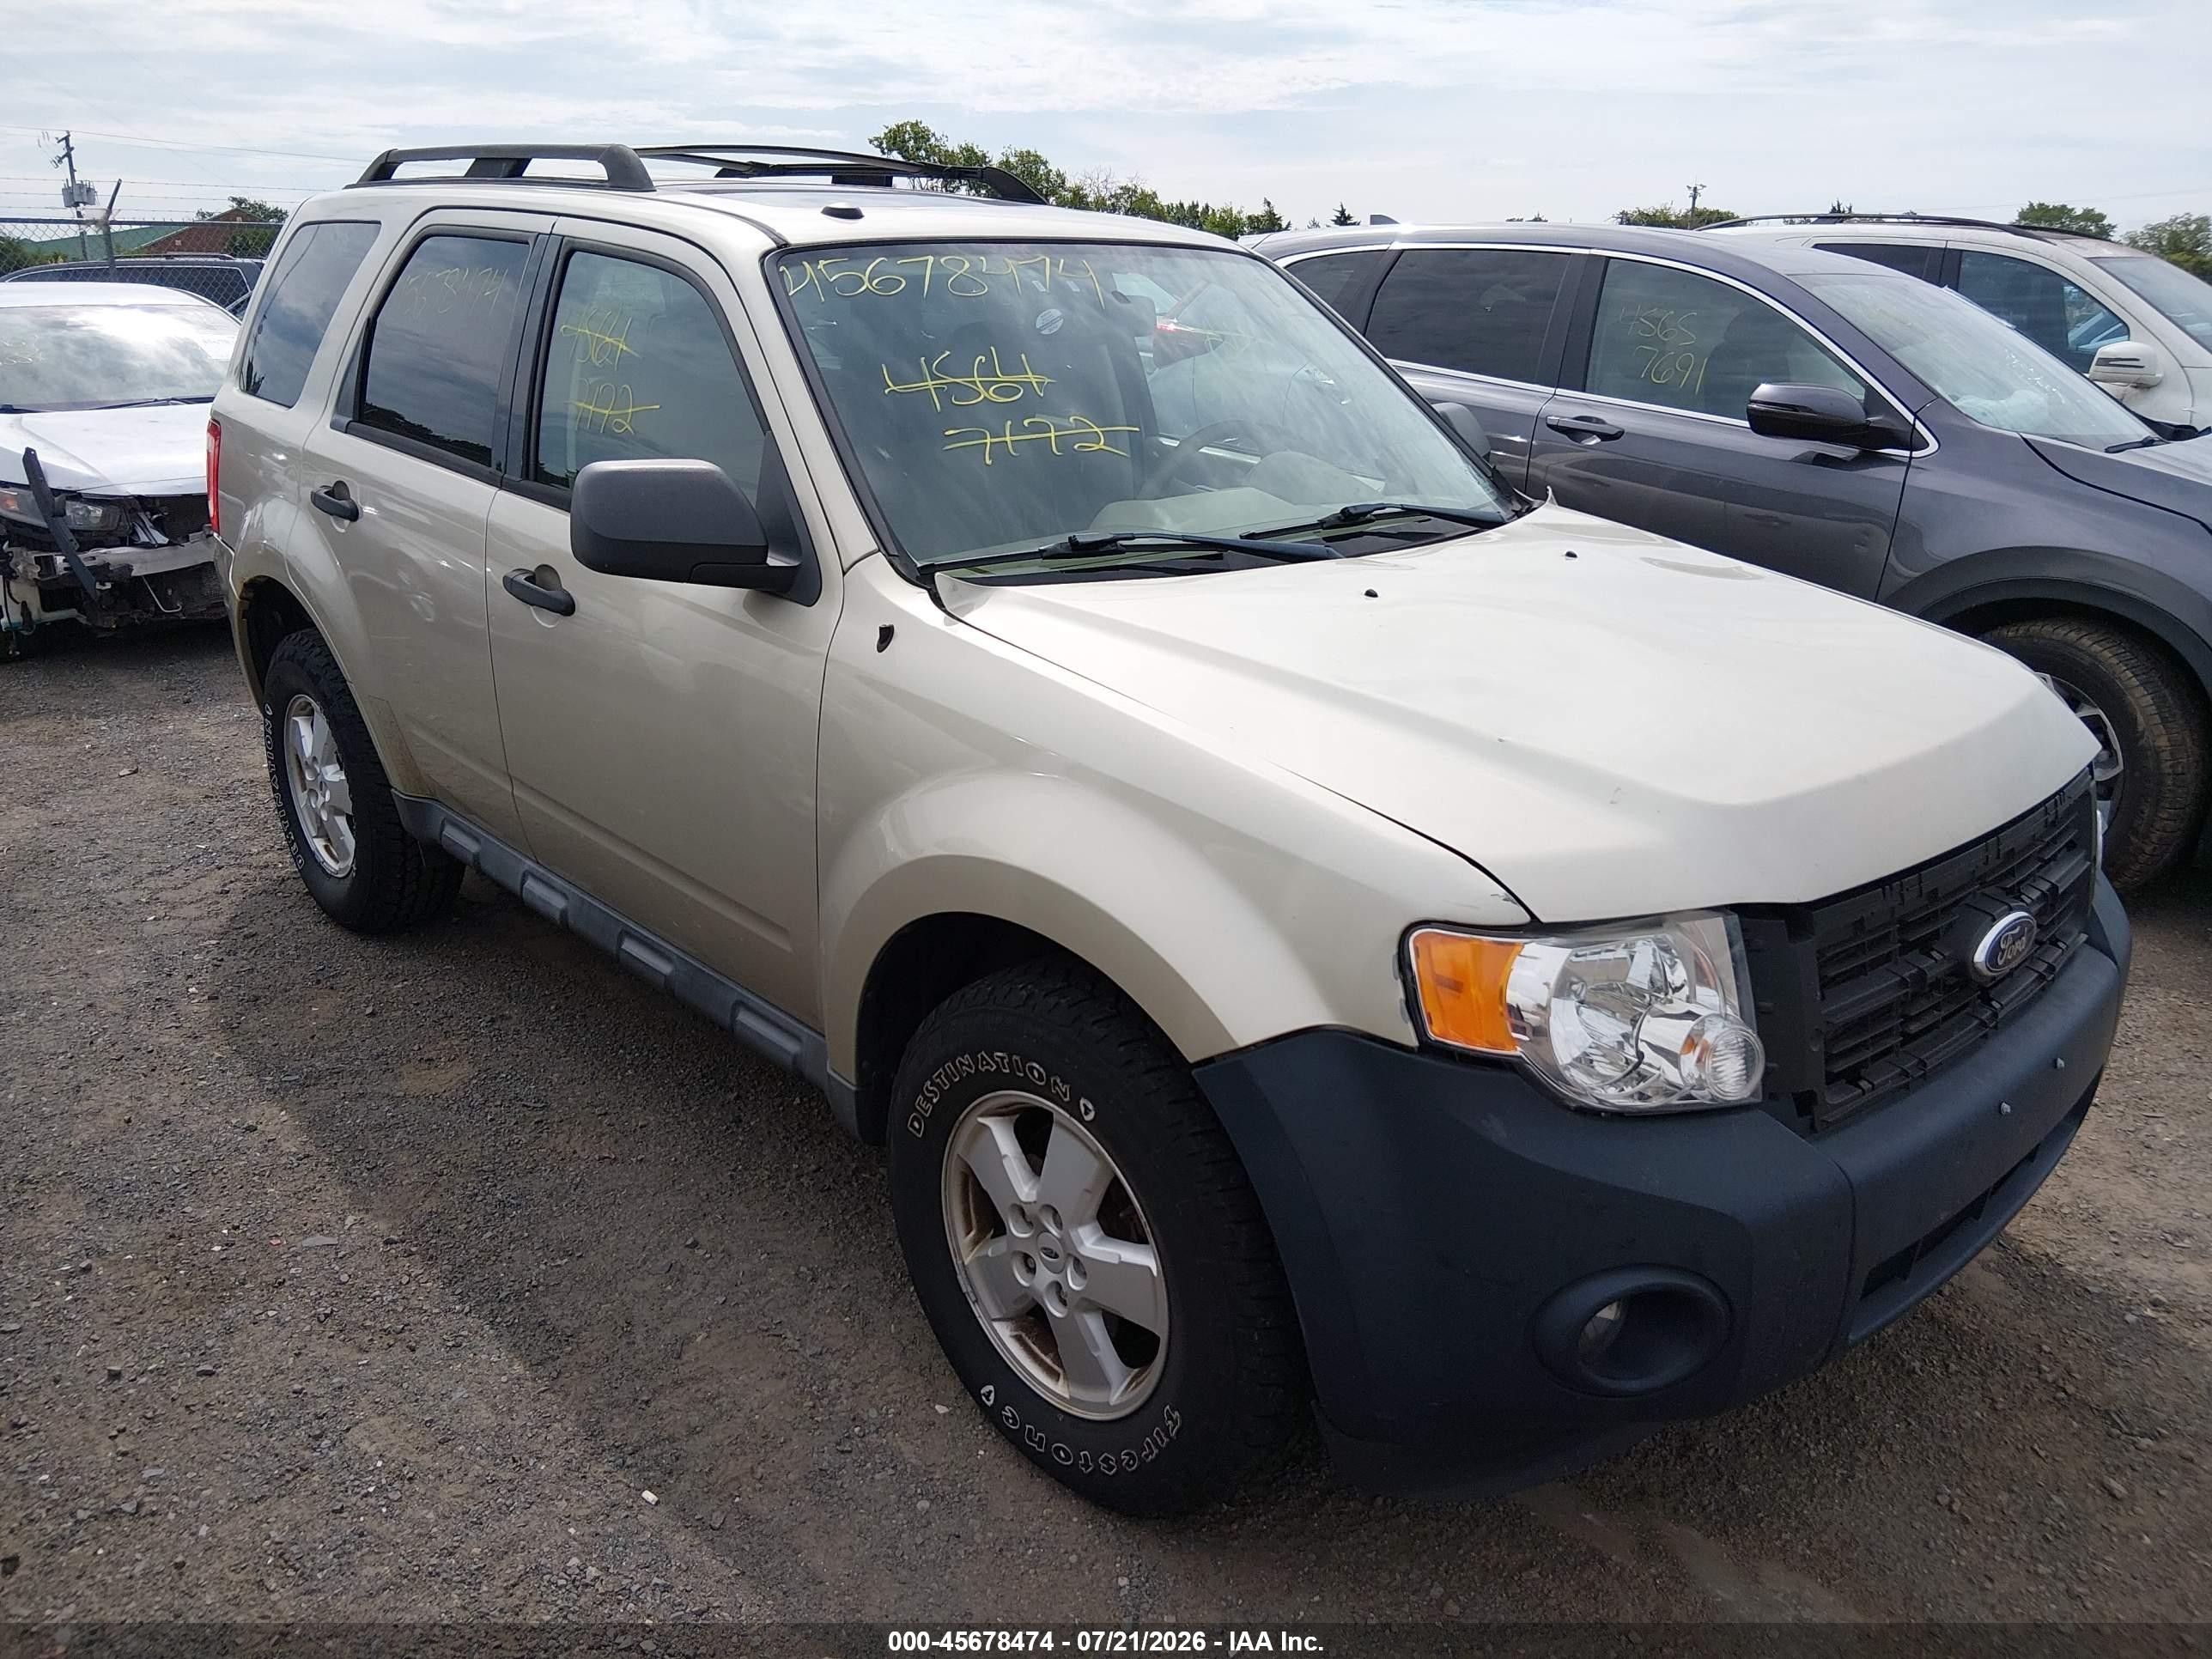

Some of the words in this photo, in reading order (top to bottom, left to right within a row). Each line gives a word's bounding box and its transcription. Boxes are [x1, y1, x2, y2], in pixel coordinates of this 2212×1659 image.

[779, 255, 1105, 309] 45678474
[1620, 305, 1697, 346] 4565
[881, 346, 1057, 412] 4564
[1635, 345, 1708, 395] 7691
[942, 416, 1140, 465] 7172
[908, 1050, 1072, 1139] DESTINATION
